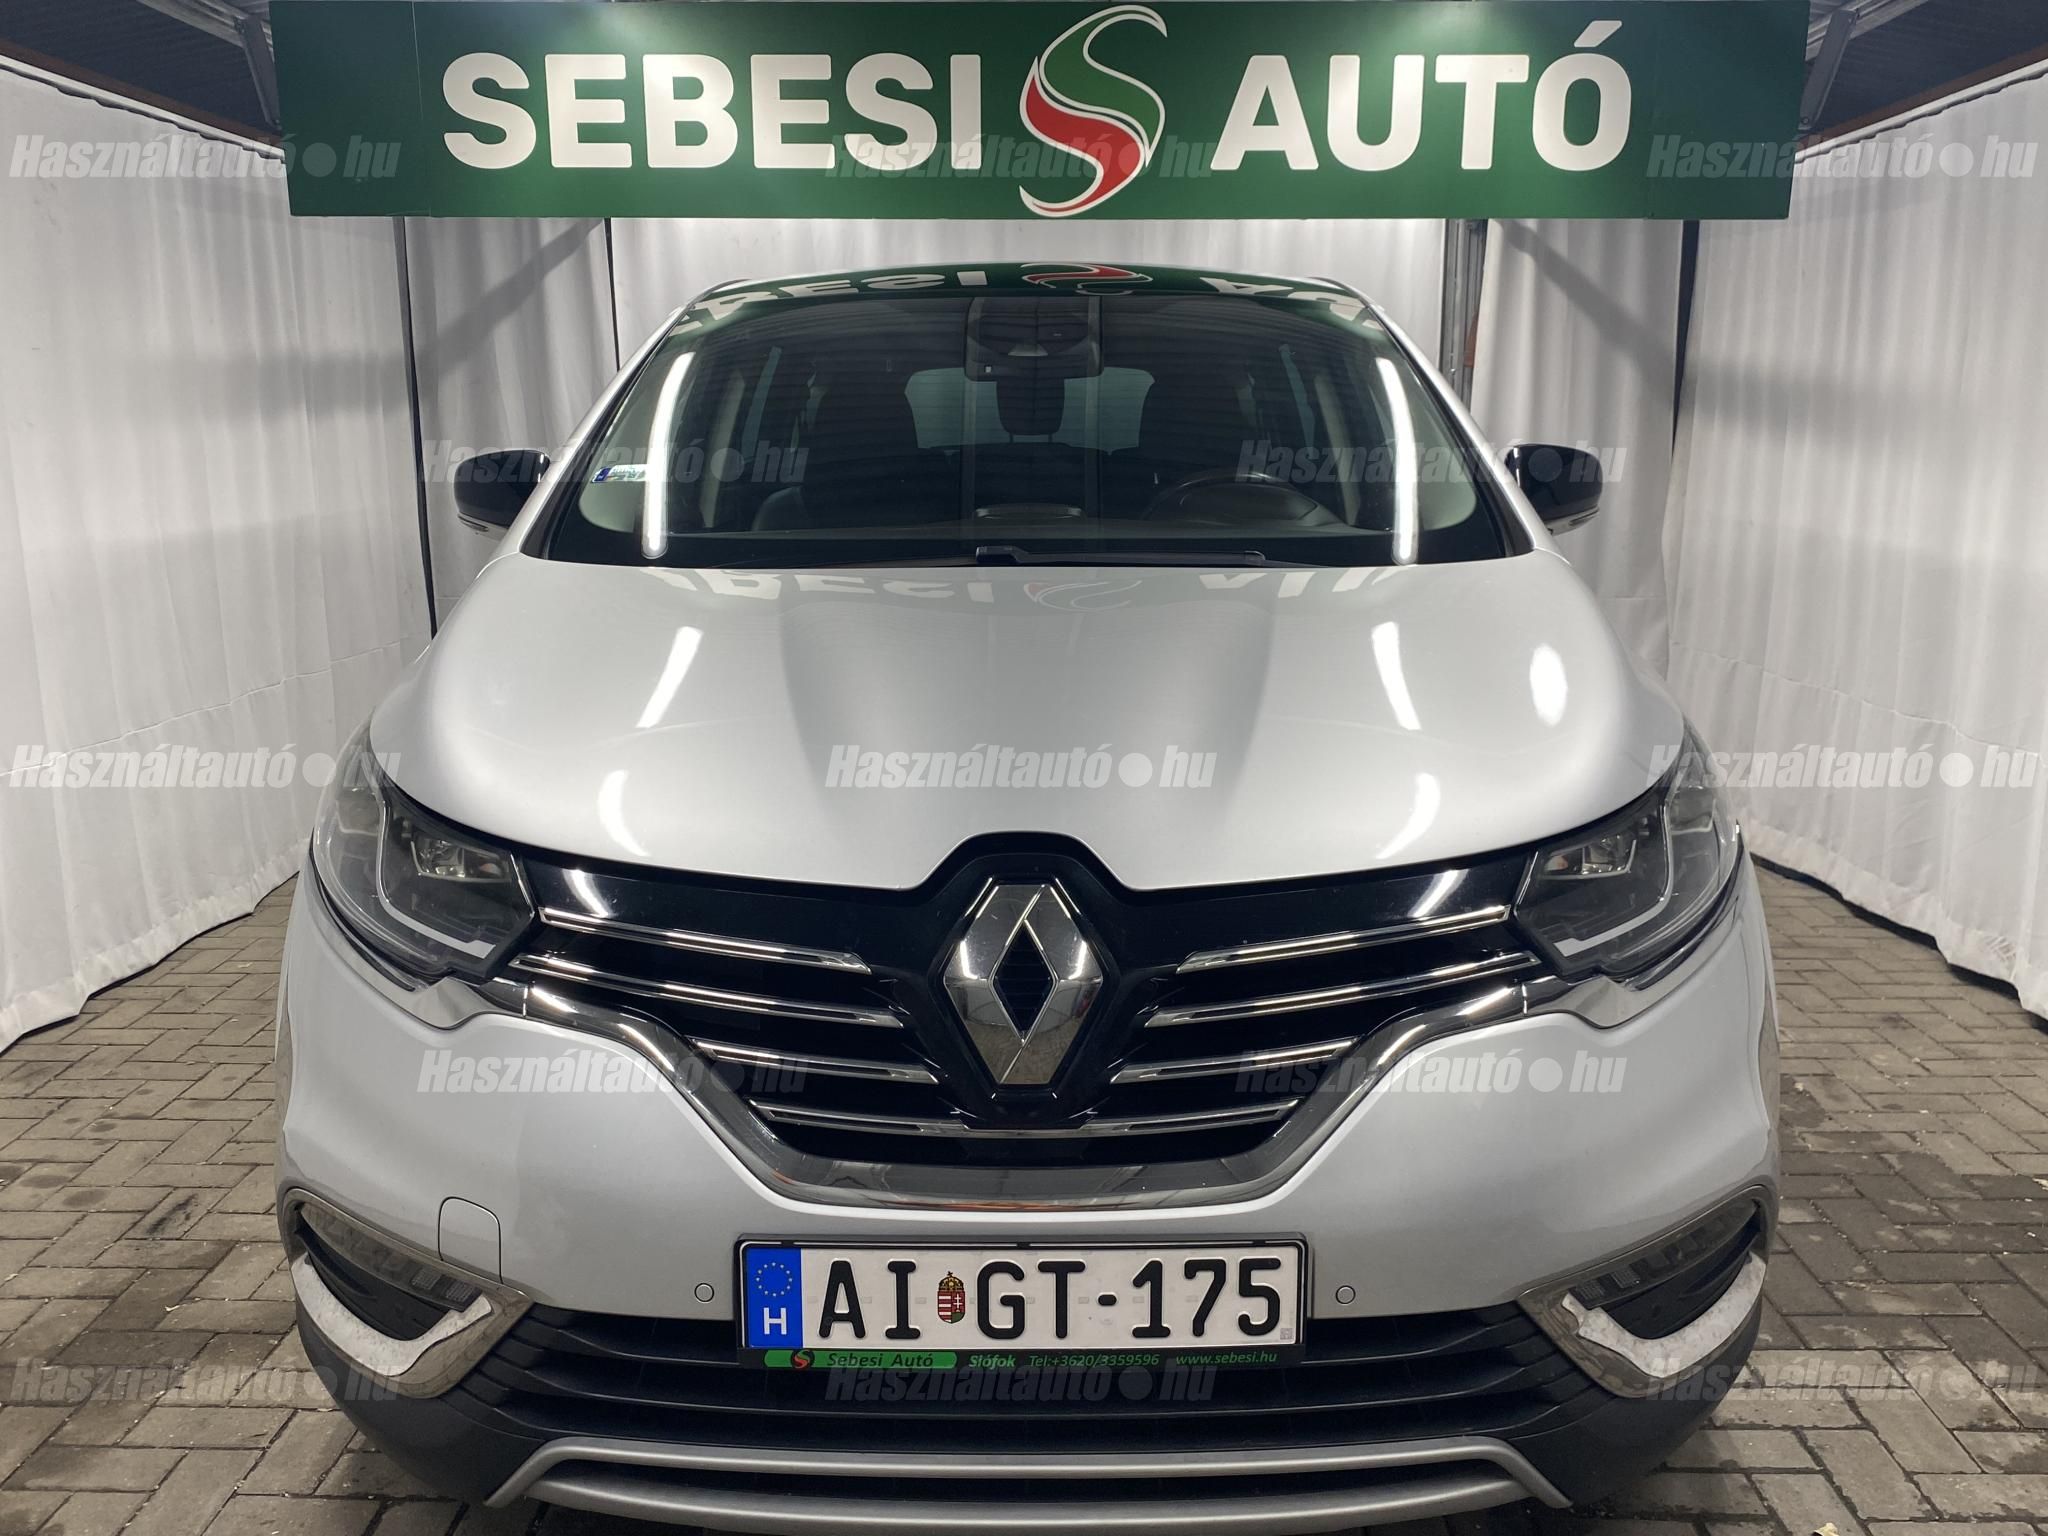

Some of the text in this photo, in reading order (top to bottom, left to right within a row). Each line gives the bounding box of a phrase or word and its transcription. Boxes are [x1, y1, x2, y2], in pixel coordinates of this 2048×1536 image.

[442, 52, 981, 170] SEBESI
[1210, 20, 1632, 171] AUTÓ
[762, 1306, 788, 1337] H
[827, 1352, 883, 1368] Sebesi
[891, 1352, 934, 1368] Autó
[968, 1354, 1016, 1370] Siófok
[1175, 1350, 1279, 1366] www.sebesi.hu
